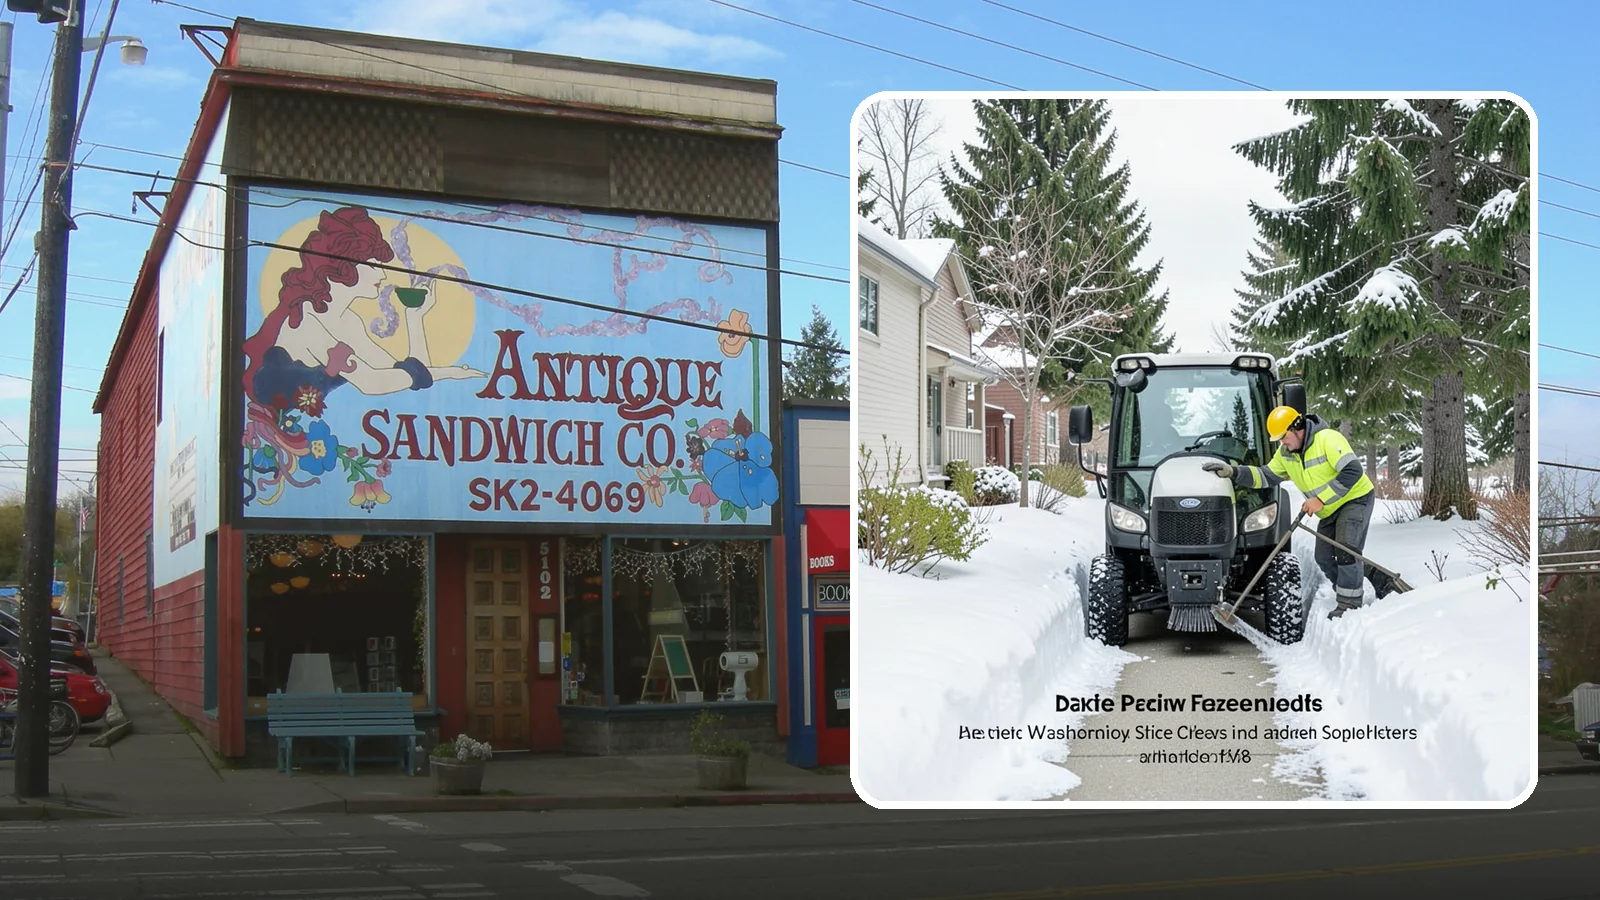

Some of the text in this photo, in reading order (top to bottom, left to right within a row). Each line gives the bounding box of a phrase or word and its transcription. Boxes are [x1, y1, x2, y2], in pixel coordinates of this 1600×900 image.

[361, 408, 685, 470] SANDWICH CO.
[468, 477, 646, 514] SK2-4069
[539, 542, 552, 600] 5102
[809, 555, 835, 569] BOOKS
